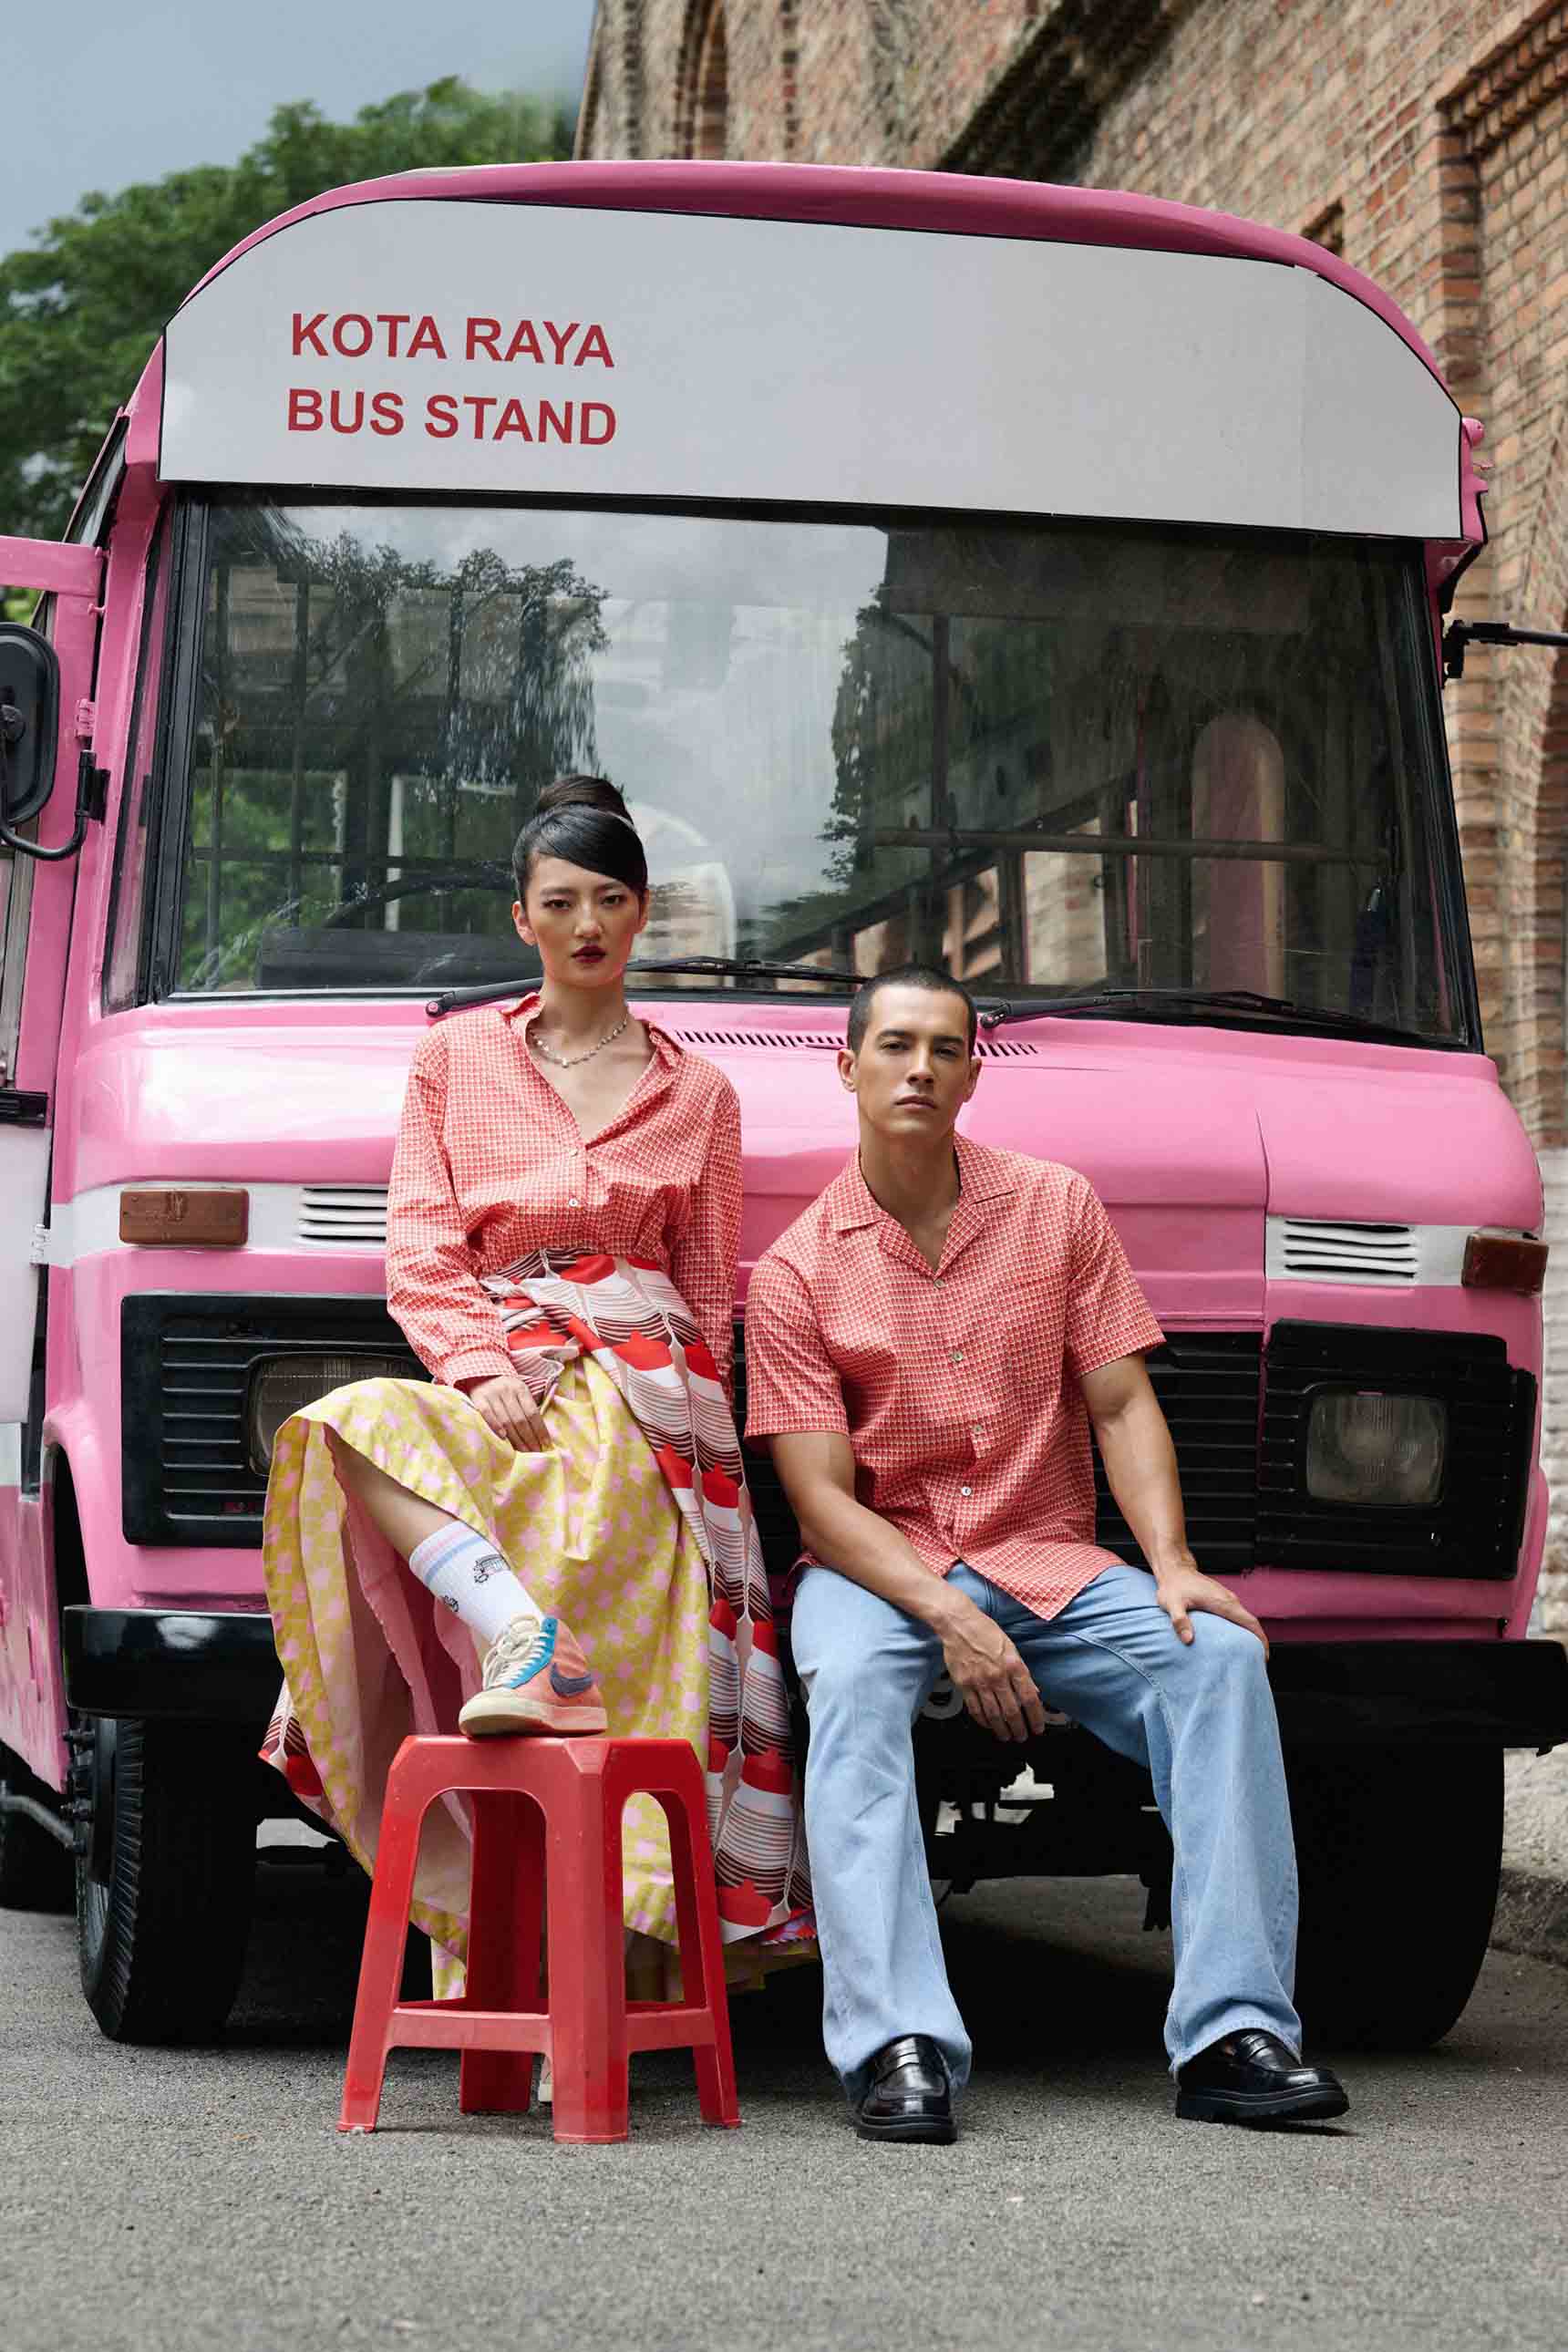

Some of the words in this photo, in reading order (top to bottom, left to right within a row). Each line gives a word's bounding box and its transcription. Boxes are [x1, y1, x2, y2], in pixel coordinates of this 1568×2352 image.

[292, 313, 446, 360] KOTA
[466, 317, 614, 368] RAYA
[287, 387, 405, 436] BUS
[425, 394, 617, 446] STAND
